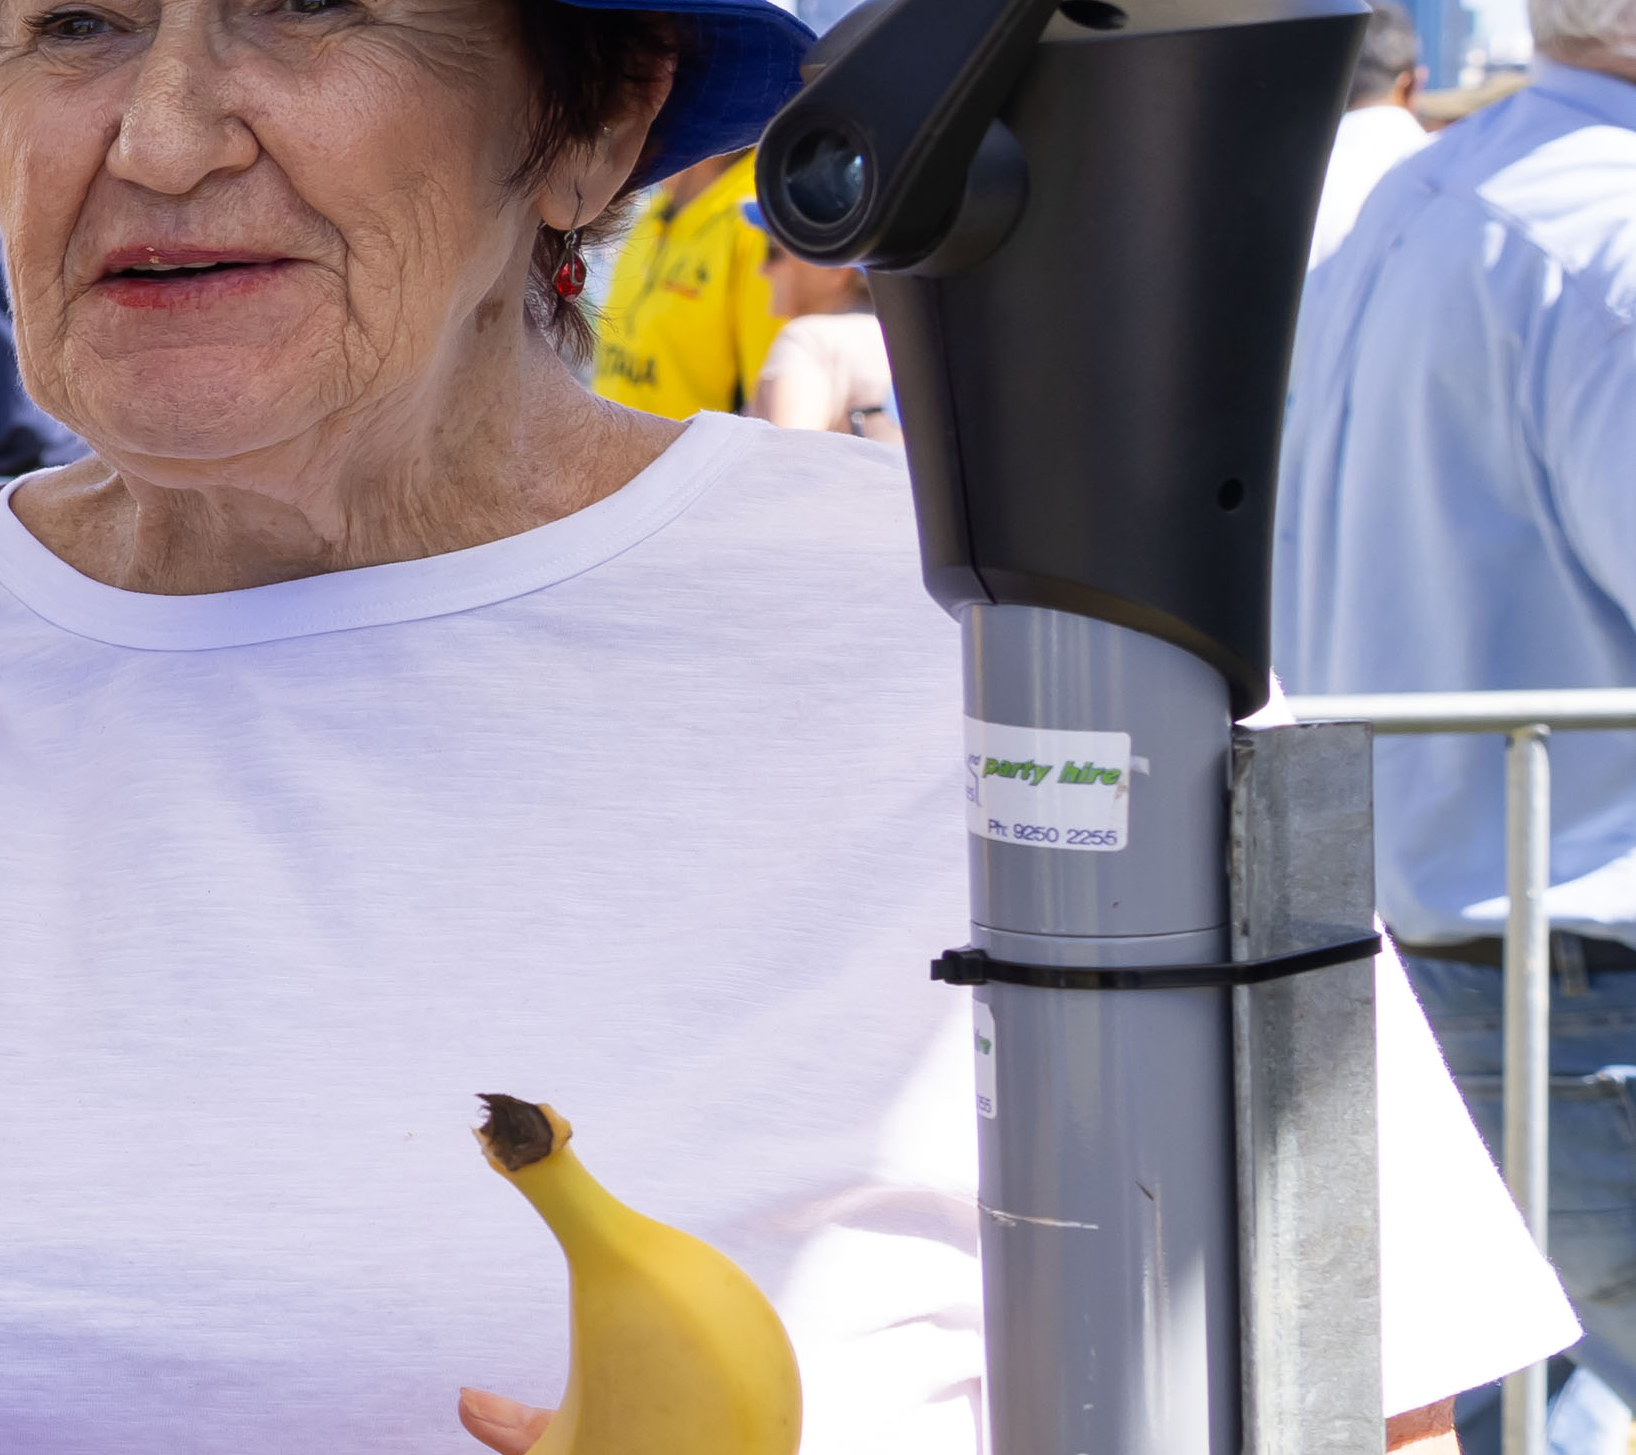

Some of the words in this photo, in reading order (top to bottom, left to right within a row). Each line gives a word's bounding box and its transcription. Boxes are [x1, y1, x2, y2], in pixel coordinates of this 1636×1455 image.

[982, 757, 1054, 786] party
[1057, 760, 1123, 786] hire
[1013, 823, 1060, 844] 9250
[1066, 828, 1118, 846] 2255
